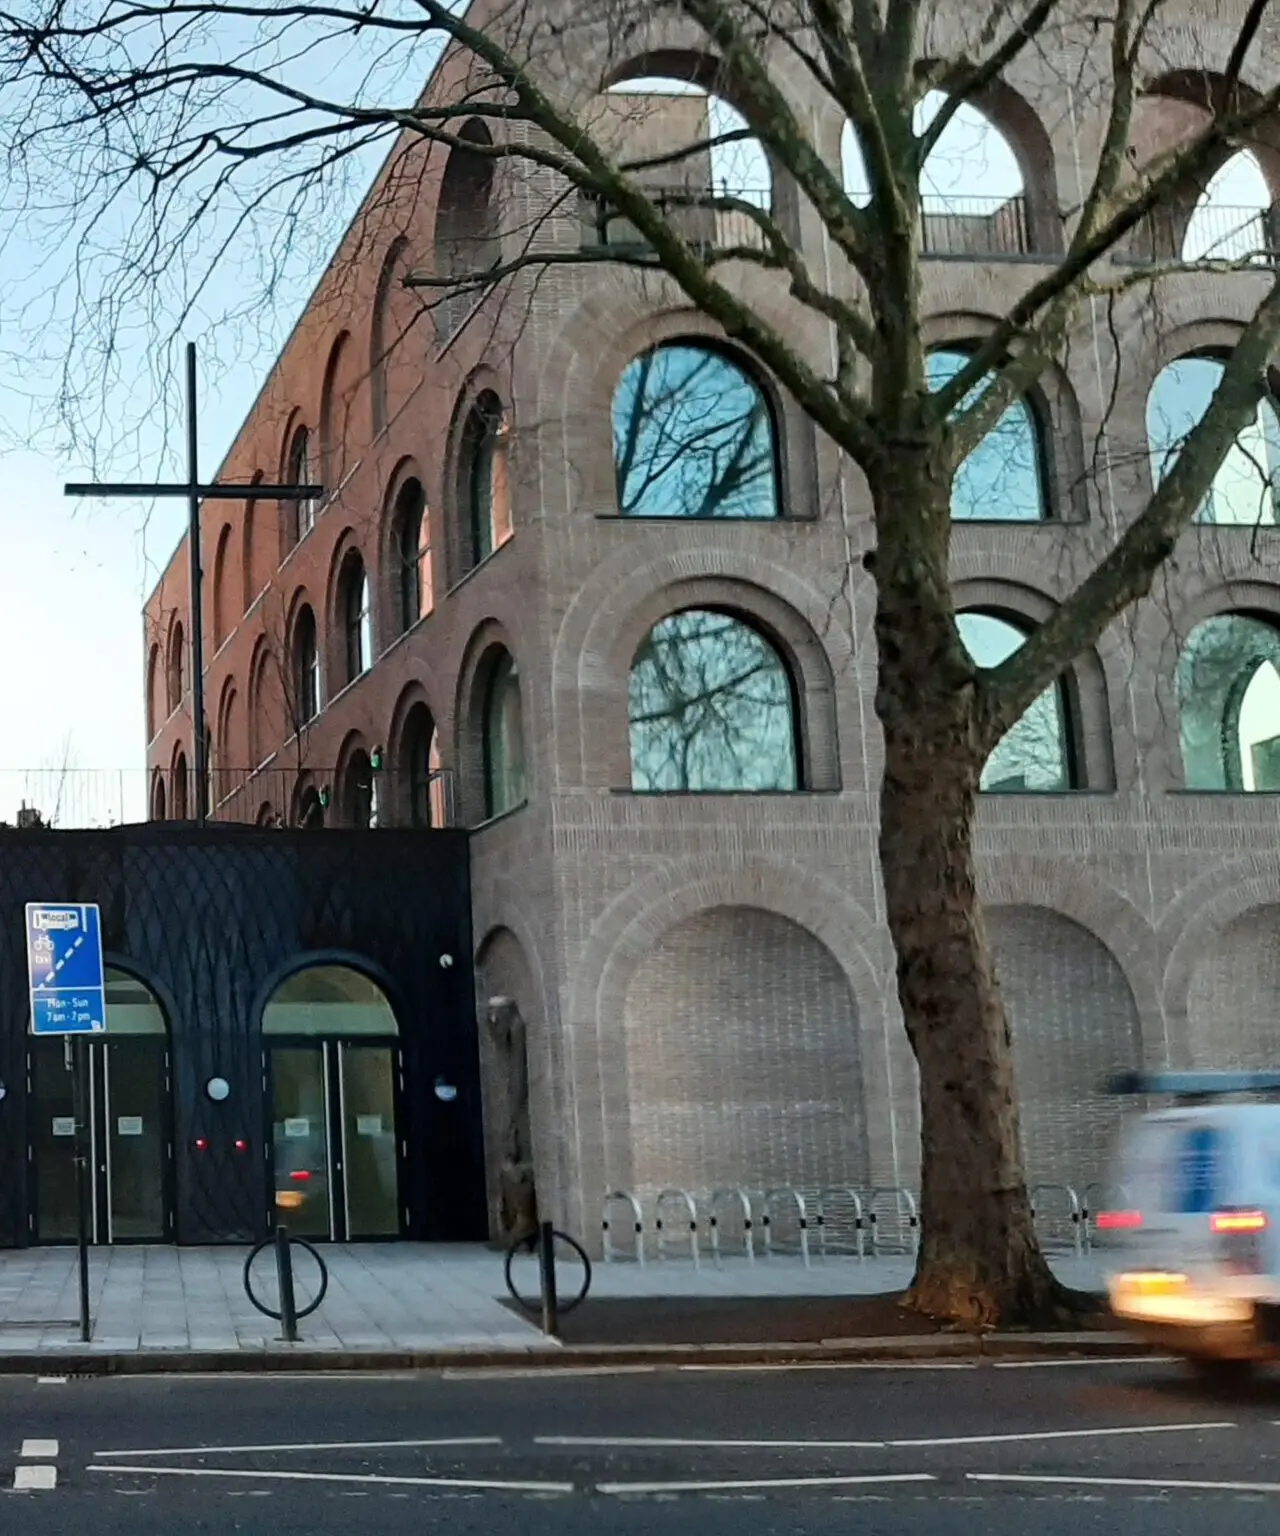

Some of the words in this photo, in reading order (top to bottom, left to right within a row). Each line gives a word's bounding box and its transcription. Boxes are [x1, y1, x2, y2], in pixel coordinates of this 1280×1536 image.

[47, 912, 68, 922] local
[35, 954, 51, 965] taxi
[47, 997, 66, 1009] Mon
[72, 997, 89, 1008] Sun
